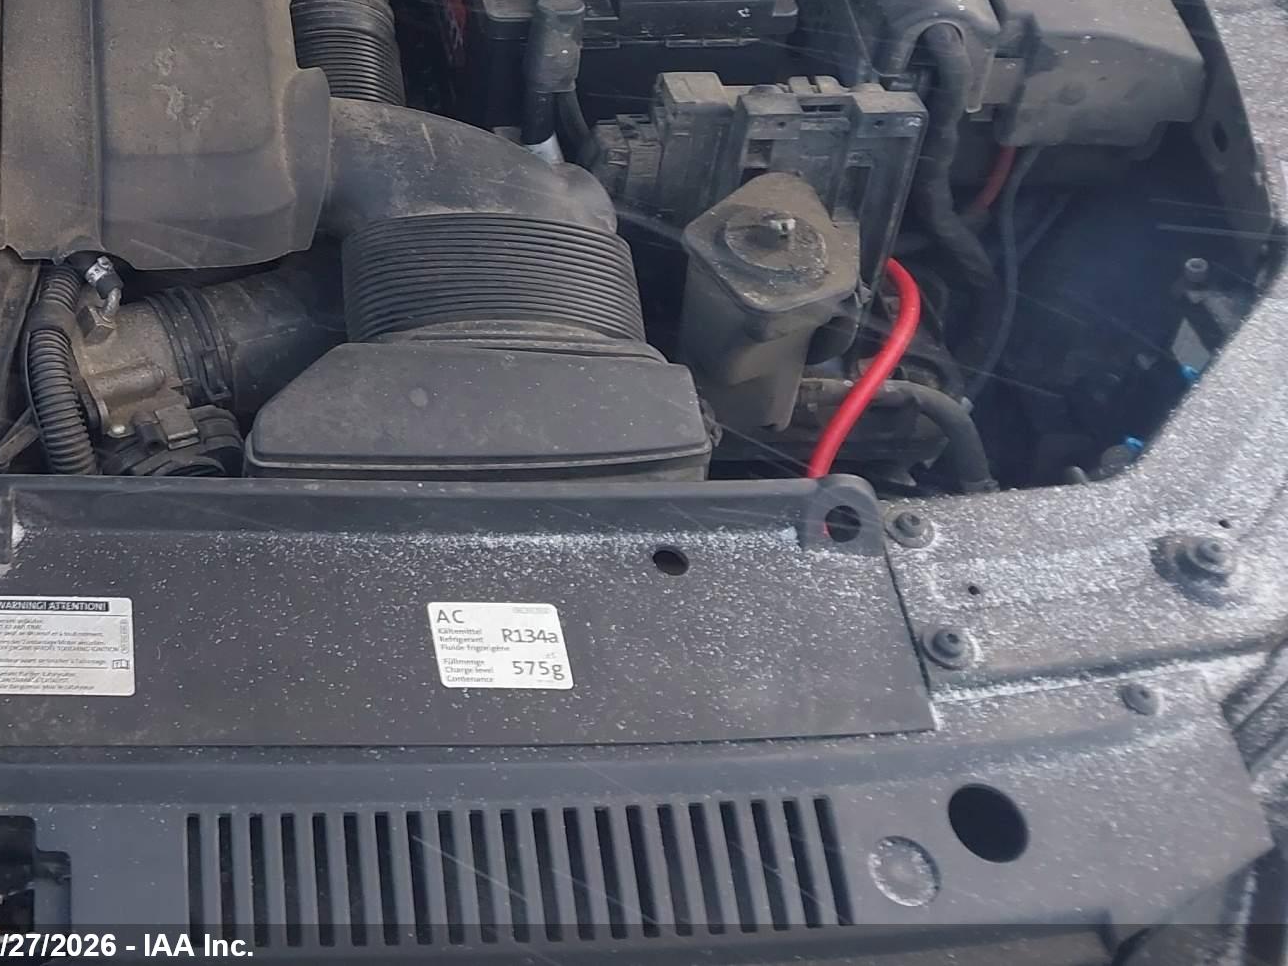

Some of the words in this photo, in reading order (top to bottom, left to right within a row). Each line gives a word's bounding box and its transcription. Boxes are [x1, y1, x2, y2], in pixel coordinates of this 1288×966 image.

[48, 601, 108, 611] ATTENTION!
[436, 609, 465, 624] AC
[439, 636, 484, 644] Refrigerant
[501, 628, 559, 644] R134a
[445, 666, 473, 675] Charge
[511, 661, 565, 681] 575g
